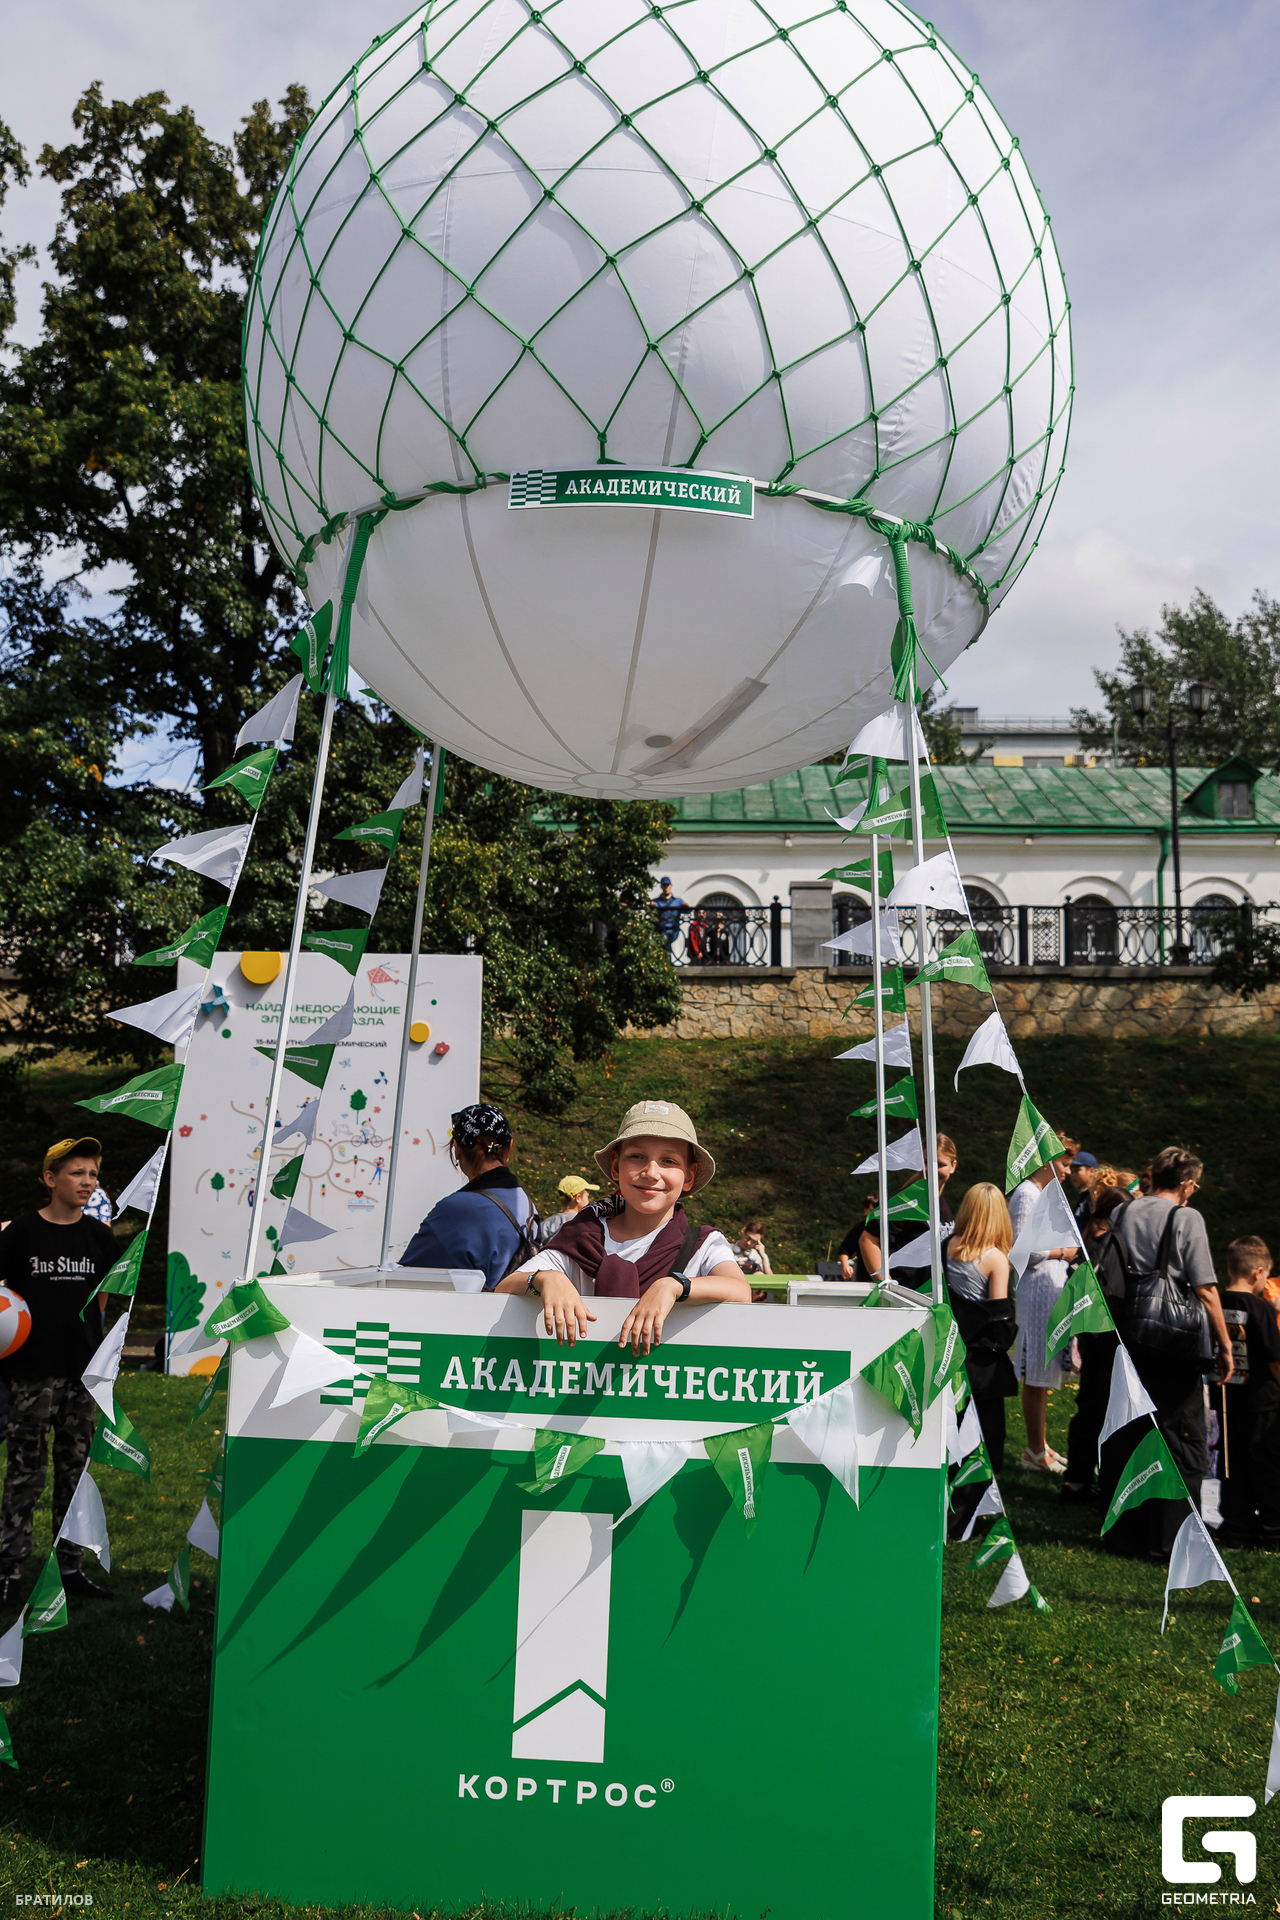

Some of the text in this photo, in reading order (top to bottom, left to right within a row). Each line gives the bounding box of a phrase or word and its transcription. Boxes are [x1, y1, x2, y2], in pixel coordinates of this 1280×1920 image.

[564, 478, 741, 505] АКАДЕМИЧЕСКИЙ
[246, 1001, 292, 1012] НАЙД
[261, 1015, 328, 1025] ЭЛМЕНТ
[440, 1356, 823, 1404] АКАДЕМИЧЕСКИЙ
